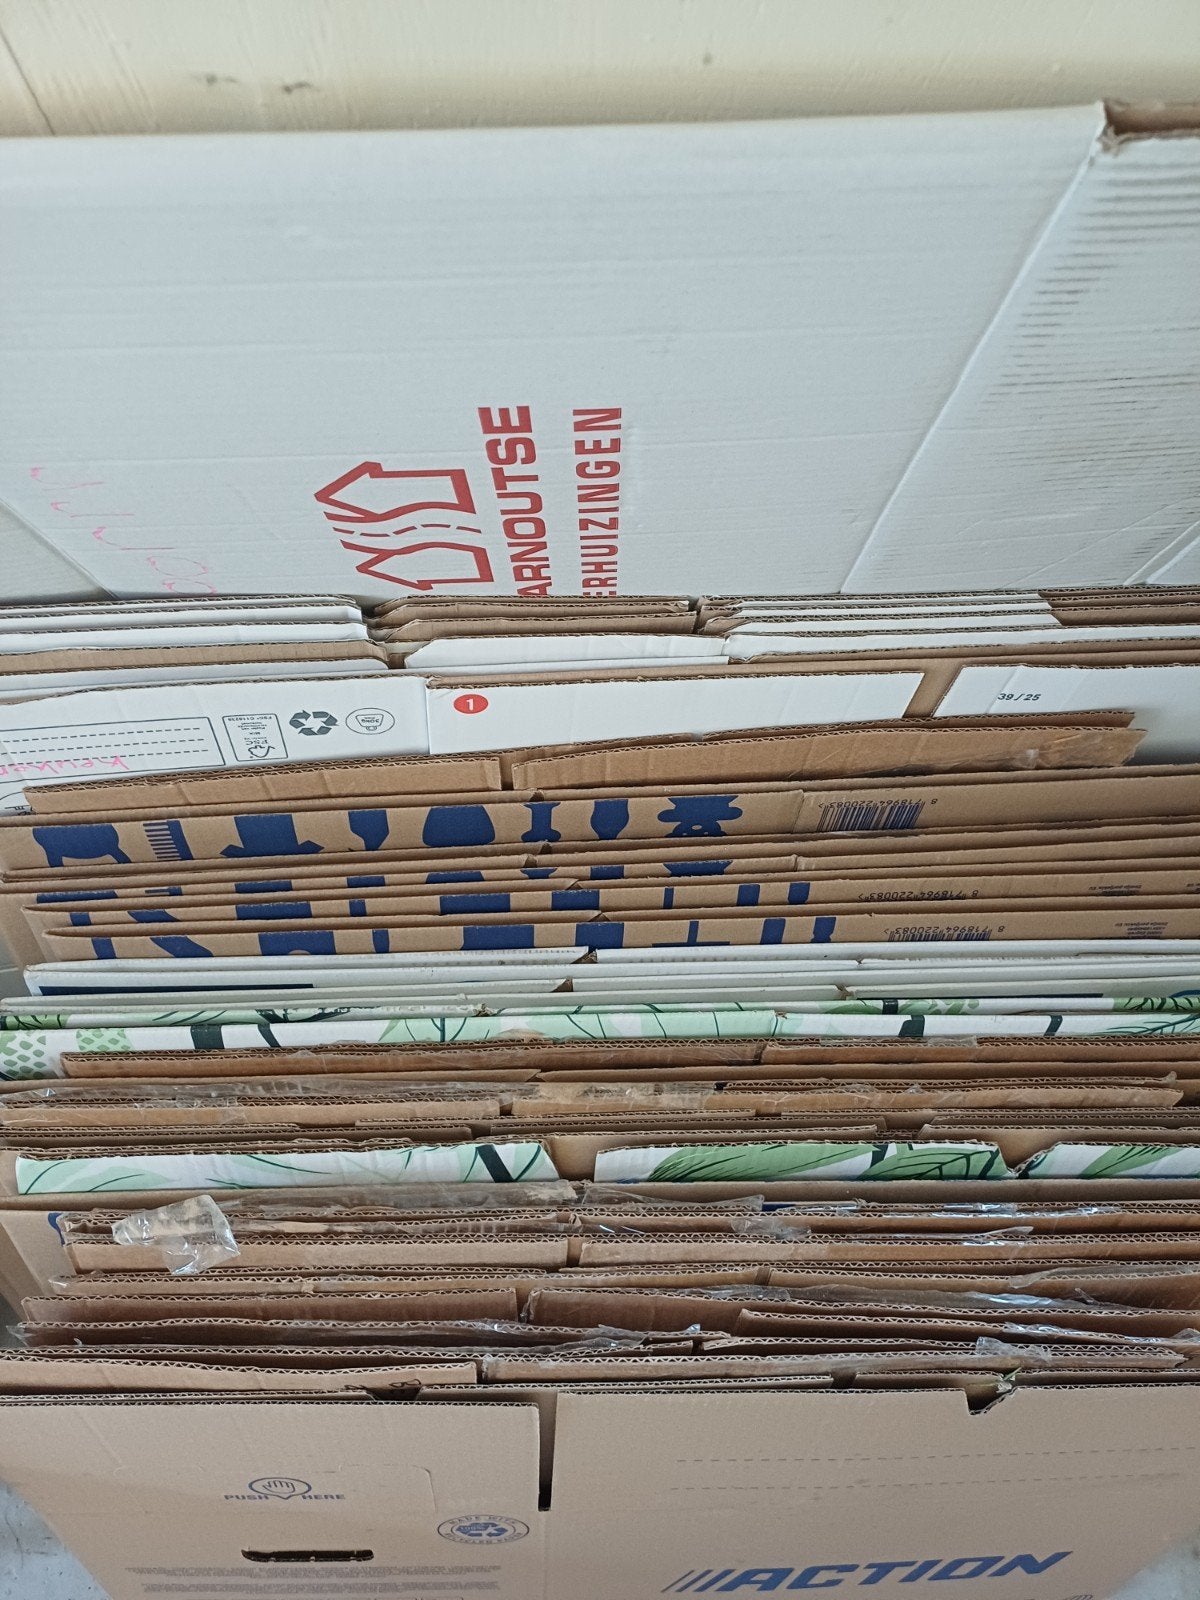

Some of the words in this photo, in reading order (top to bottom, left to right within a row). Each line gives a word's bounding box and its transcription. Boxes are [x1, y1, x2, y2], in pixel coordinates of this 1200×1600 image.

[478, 405, 552, 596] ARNOUTSE
[572, 407, 622, 597] ERHUIZINGEN
[465, 698, 475, 711] 1
[972, 889, 979, 898] 8
[997, 925, 1005, 933] 8
[224, 1493, 270, 1501] PUSH
[302, 1492, 346, 1501] HERE
[714, 1550, 1074, 1593] ACTION
